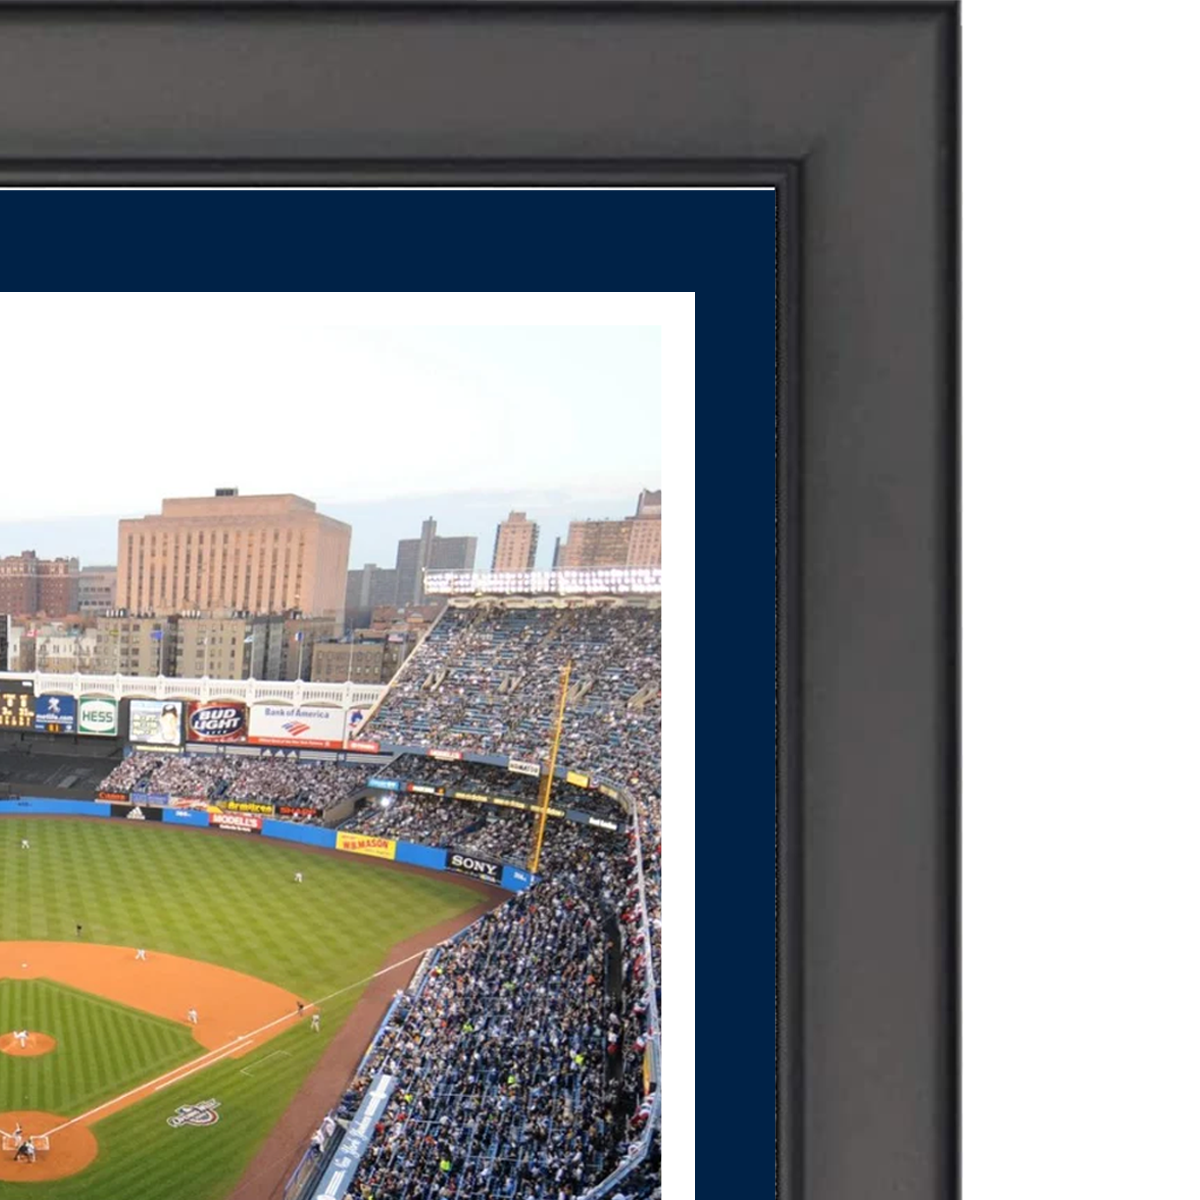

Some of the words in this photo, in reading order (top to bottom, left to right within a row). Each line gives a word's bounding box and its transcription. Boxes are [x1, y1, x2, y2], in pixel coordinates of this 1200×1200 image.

[82, 711, 113, 723] HESS
[199, 708, 236, 720] BUD
[265, 708, 285, 716] Bank
[286, 708, 295, 717] of
[295, 710, 329, 718] America
[194, 718, 240, 730] LIGHT
[451, 854, 497, 875] SONY
